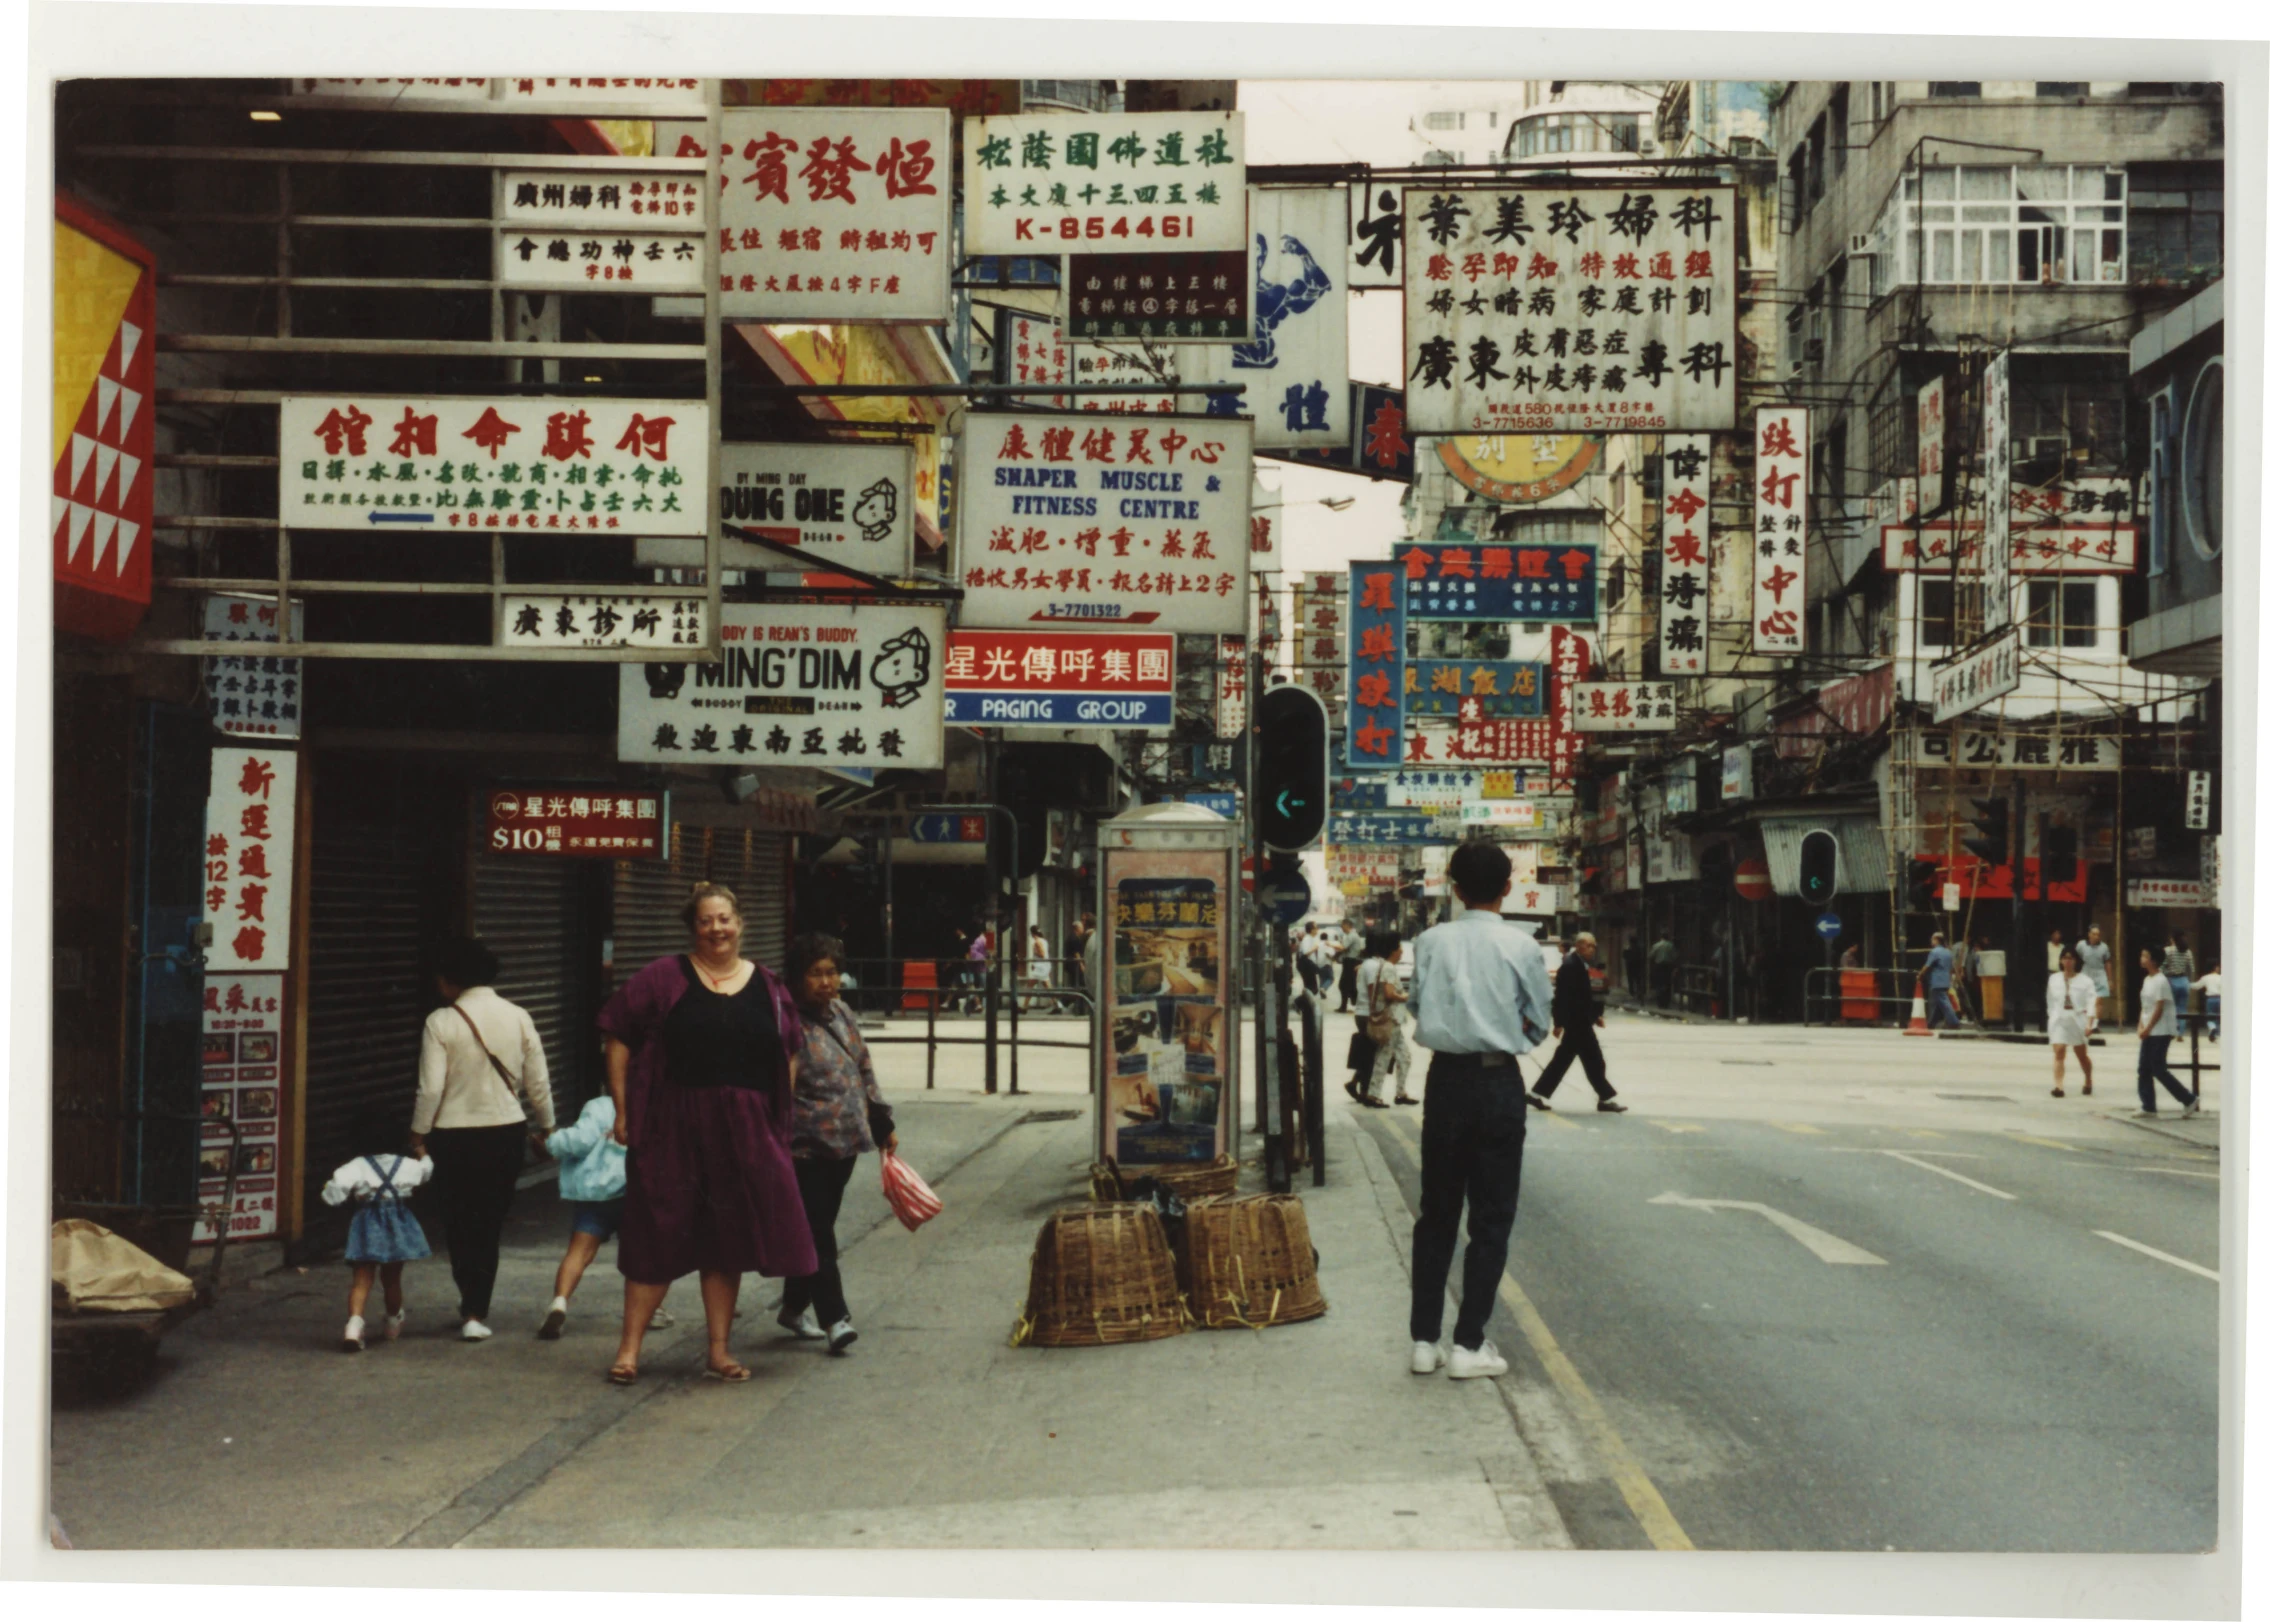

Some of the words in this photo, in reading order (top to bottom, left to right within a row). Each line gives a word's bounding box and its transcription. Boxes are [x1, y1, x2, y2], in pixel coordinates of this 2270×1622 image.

[675, 131, 937, 205] 恒發賓
[514, 183, 621, 209] 廣州婦科
[1015, 216, 1194, 240] K-854461
[1419, 193, 1722, 247] 葉美玲婦科
[840, 228, 938, 255] 時租均可
[1580, 250, 1714, 281] 特效通經
[1426, 288, 1556, 318] 婦女暗病
[1577, 285, 1712, 317] 家庭計劃
[1410, 335, 1510, 391] 廣東
[1632, 339, 1732, 388] 專科
[1472, 417, 1554, 429] 3-7715636
[1583, 416, 1666, 429] 3-7719845
[997, 424, 1226, 465] 康體健美中心
[1760, 417, 1803, 510] 跌打
[737, 473, 750, 484] BY
[756, 473, 781, 485] MING
[994, 467, 1078, 489] SHAPER
[1101, 470, 1184, 492] MUSCLE
[1205, 476, 1221, 491] &
[722, 487, 784, 521] OUNG
[794, 488, 845, 522] ONE
[1012, 495, 1098, 516] FITNESS
[1120, 499, 1200, 520] CENTRE
[1048, 604, 1122, 617] 3-7701322
[1760, 564, 1799, 636] 中心
[513, 604, 662, 638] 廣東診所
[722, 626, 746, 641] DDY
[753, 626, 763, 640] IS
[769, 626, 809, 642] REAN'S
[945, 646, 1170, 682] 星光傳呼集團
[982, 699, 1052, 718] PAGING
[1077, 700, 1147, 719] GROUP
[524, 797, 657, 819] 星光傳呼集團
[493, 827, 543, 850] $10
